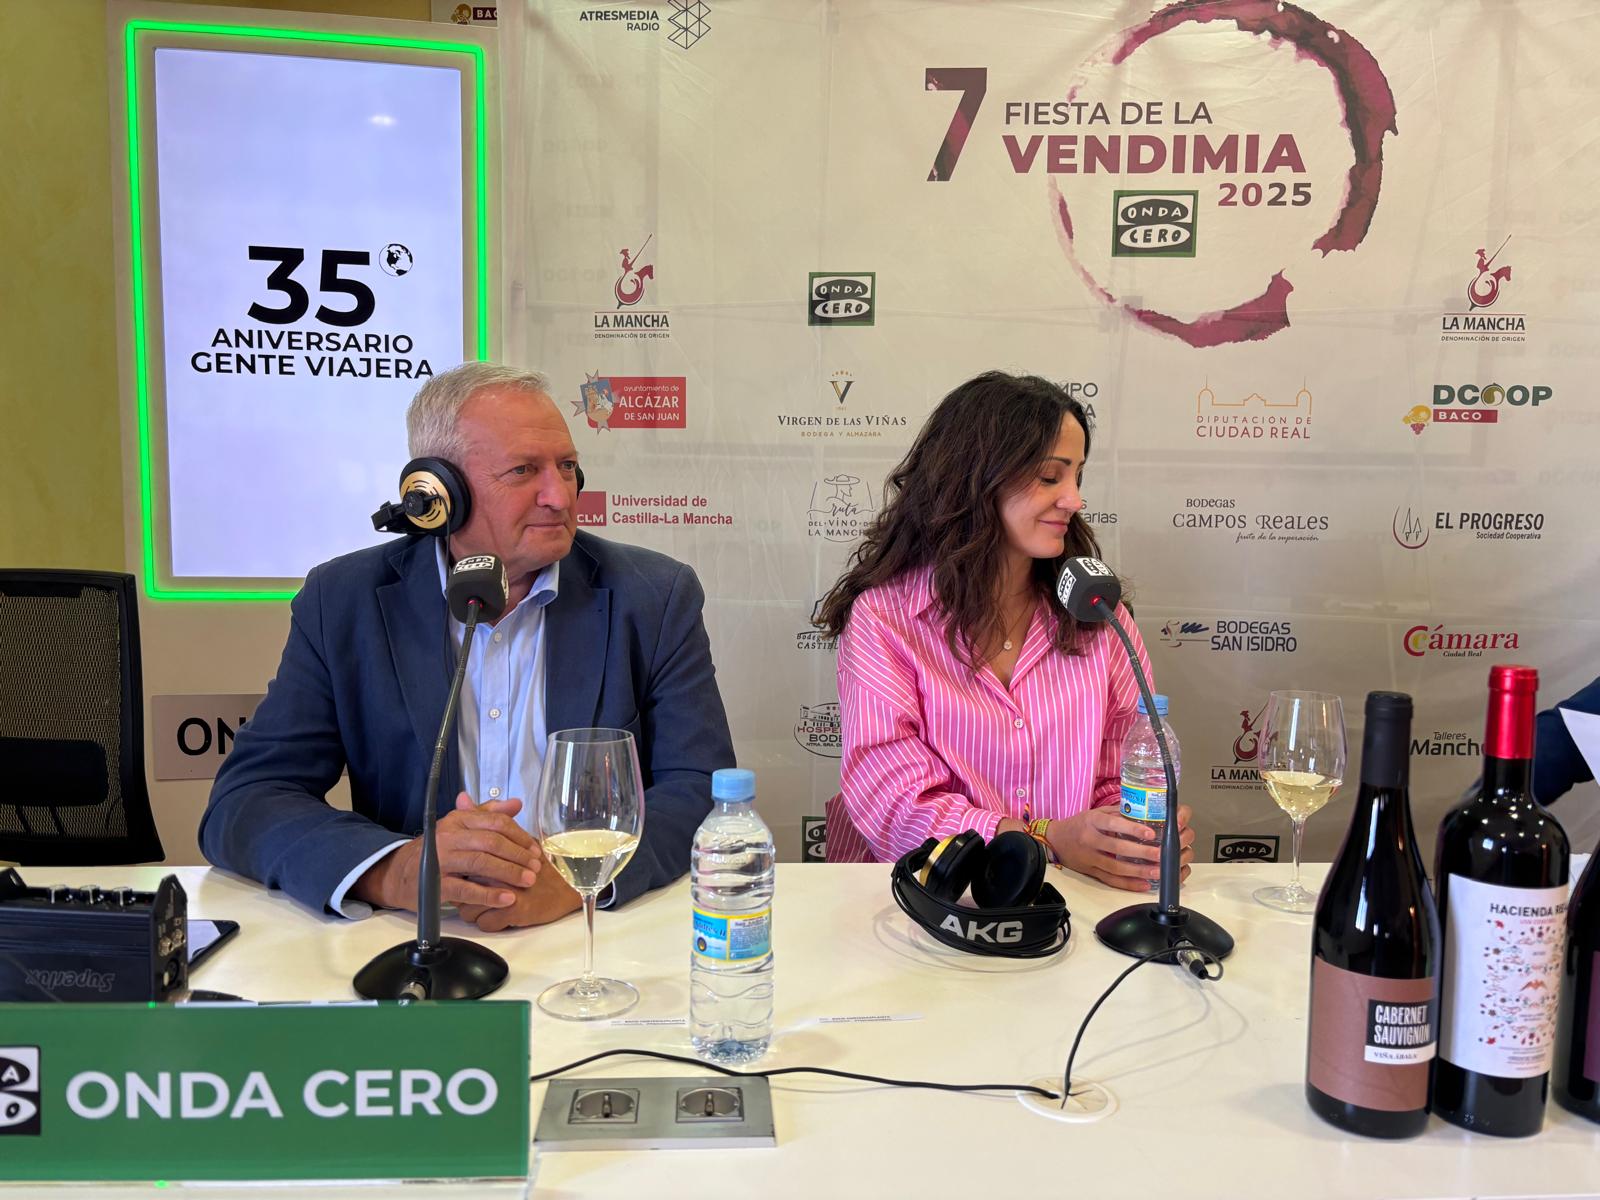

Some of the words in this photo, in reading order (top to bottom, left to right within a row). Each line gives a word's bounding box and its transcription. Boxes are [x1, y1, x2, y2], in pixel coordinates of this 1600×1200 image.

[579, 10, 659, 21] ATRESMEDIA
[626, 22, 660, 31] RADIO
[1005, 102, 1111, 126] FIESTA
[1121, 101, 1163, 126] DE
[1174, 101, 1213, 125] LA
[925, 67, 988, 182] 7
[1002, 133, 1307, 174] VENDIMIA
[1217, 182, 1313, 207] 2025
[1127, 206, 1182, 219] ONDA
[1129, 228, 1182, 243] CERO
[247, 245, 376, 327] 35
[820, 285, 863, 295] ONDA
[821, 302, 863, 314] CERO
[594, 314, 610, 328] LA
[612, 314, 670, 328] MANCHA
[1442, 316, 1459, 330] LA
[1463, 317, 1526, 331] MANCHA
[211, 328, 413, 354] ANIVERSARIO
[191, 351, 295, 375] GENTE
[304, 355, 434, 379] VIAJERA
[1055, 382, 1098, 397] MPO
[1432, 383, 1553, 407] DCOOP
[619, 392, 679, 408] ALCÁZAR
[624, 412, 636, 420] DE
[637, 412, 655, 420] SAN
[656, 412, 680, 421] JUAN
[777, 415, 822, 426] VIRGEN
[826, 417, 839, 426] DE
[843, 417, 861, 426] LAS
[865, 414, 907, 426] VIÑAS
[1196, 415, 1287, 424] DIPUTACIÓN
[1295, 416, 1312, 425] DE
[1438, 411, 1482, 421] BACO
[1196, 425, 1264, 438] CIUDAD
[1270, 426, 1311, 439] REAL
[612, 494, 688, 507] Universidad
[691, 496, 707, 507] de
[577, 514, 604, 523] CLM
[612, 512, 679, 524] Castilla-La
[683, 512, 733, 525] Mancha
[1435, 512, 1453, 529] EL
[1459, 512, 1544, 530] PROGRESO
[1476, 531, 1504, 540] Sociedad
[1505, 532, 1541, 541] Cooperativa
[1216, 620, 1291, 635] BODEGAS
[1211, 636, 1242, 651] SAN
[1246, 636, 1297, 652] ISIDRO
[1403, 624, 1519, 657] Cámara
[177, 717, 247, 756] ON
[797, 726, 842, 734] HOSPE
[1433, 731, 1467, 740] Talleres
[1211, 768, 1226, 780] LA
[1229, 769, 1262, 781] MAN
[1225, 845, 1268, 855] ONDA
[1490, 903, 1553, 917] HACIENDA
[939, 913, 1024, 943] AKG
[25, 968, 116, 992] Superlux
[1375, 1004, 1428, 1025] CABERNET
[1373, 1024, 1431, 1046] SAUVIGNON
[66, 1070, 283, 1119] ONDA
[303, 1067, 499, 1118] CERO
